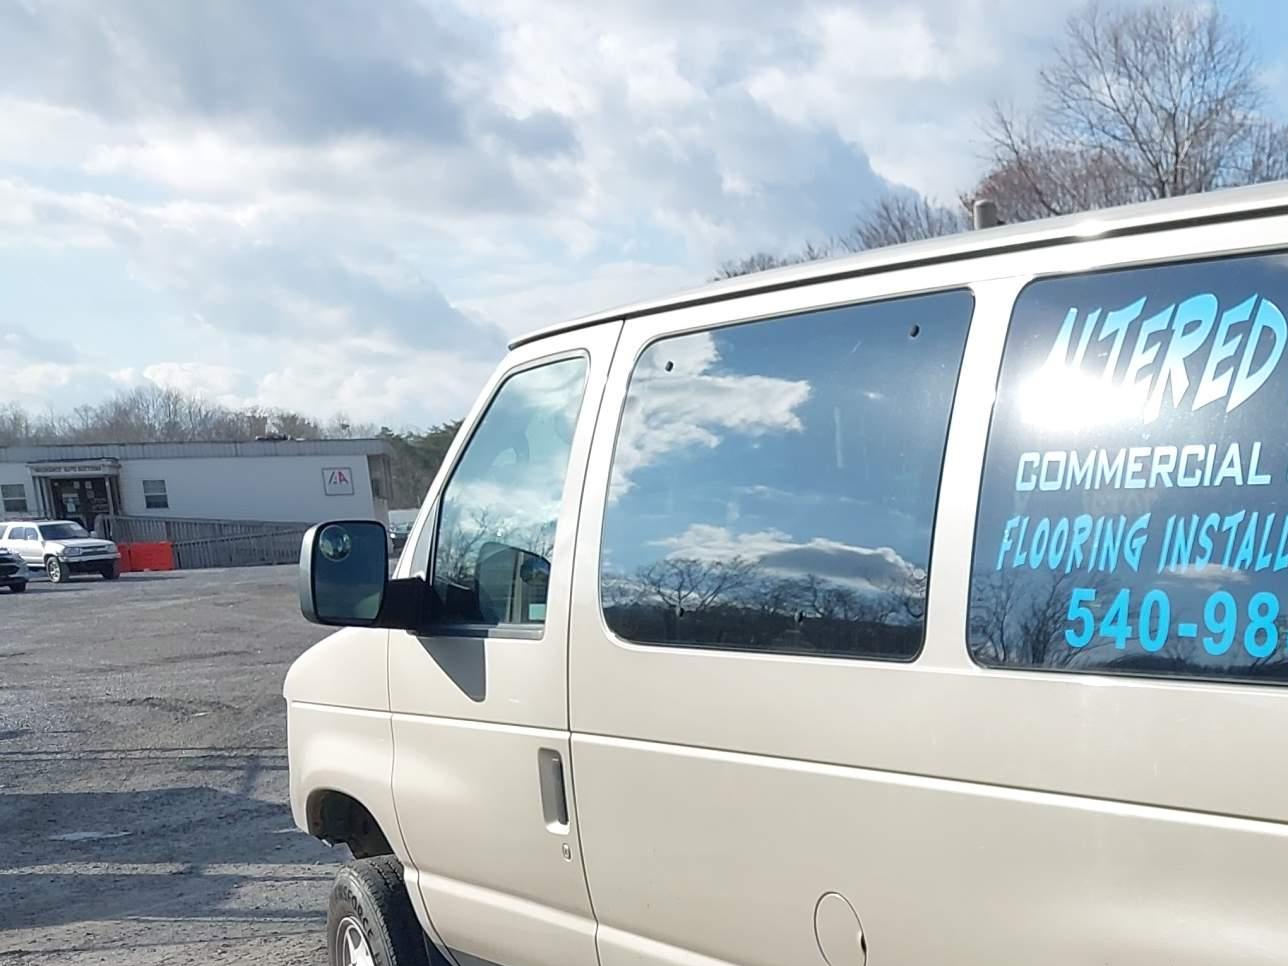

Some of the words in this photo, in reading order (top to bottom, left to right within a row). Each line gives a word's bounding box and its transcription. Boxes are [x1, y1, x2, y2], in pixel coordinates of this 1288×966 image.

[1036, 292, 1288, 424] ALTERED
[1016, 442, 1272, 491] COMMERCIAL
[996, 512, 1151, 574] FLOORING
